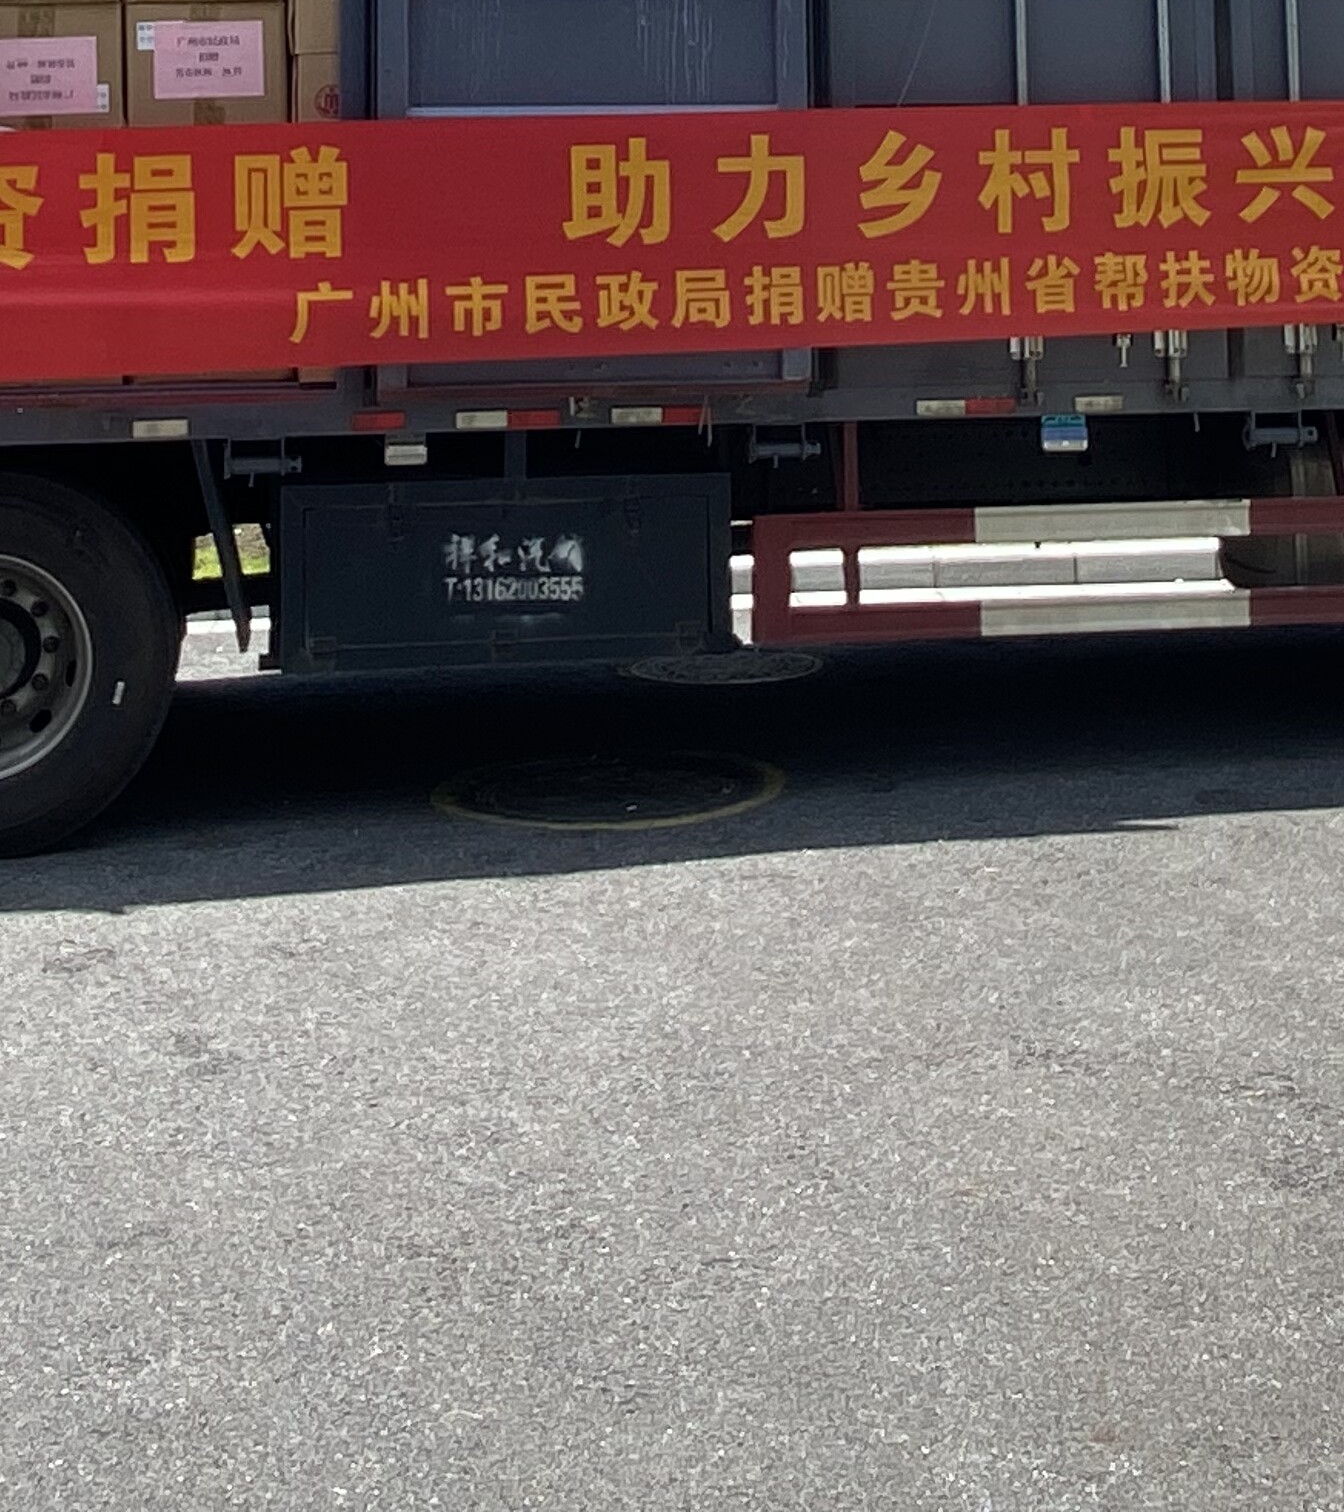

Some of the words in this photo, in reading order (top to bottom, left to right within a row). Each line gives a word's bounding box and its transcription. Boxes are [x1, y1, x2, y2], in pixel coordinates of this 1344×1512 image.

[562, 126, 1337, 248] 助力乡村振兴
[289, 245, 1344, 344] 广州市民政局捐赠贵州省帮扶物资
